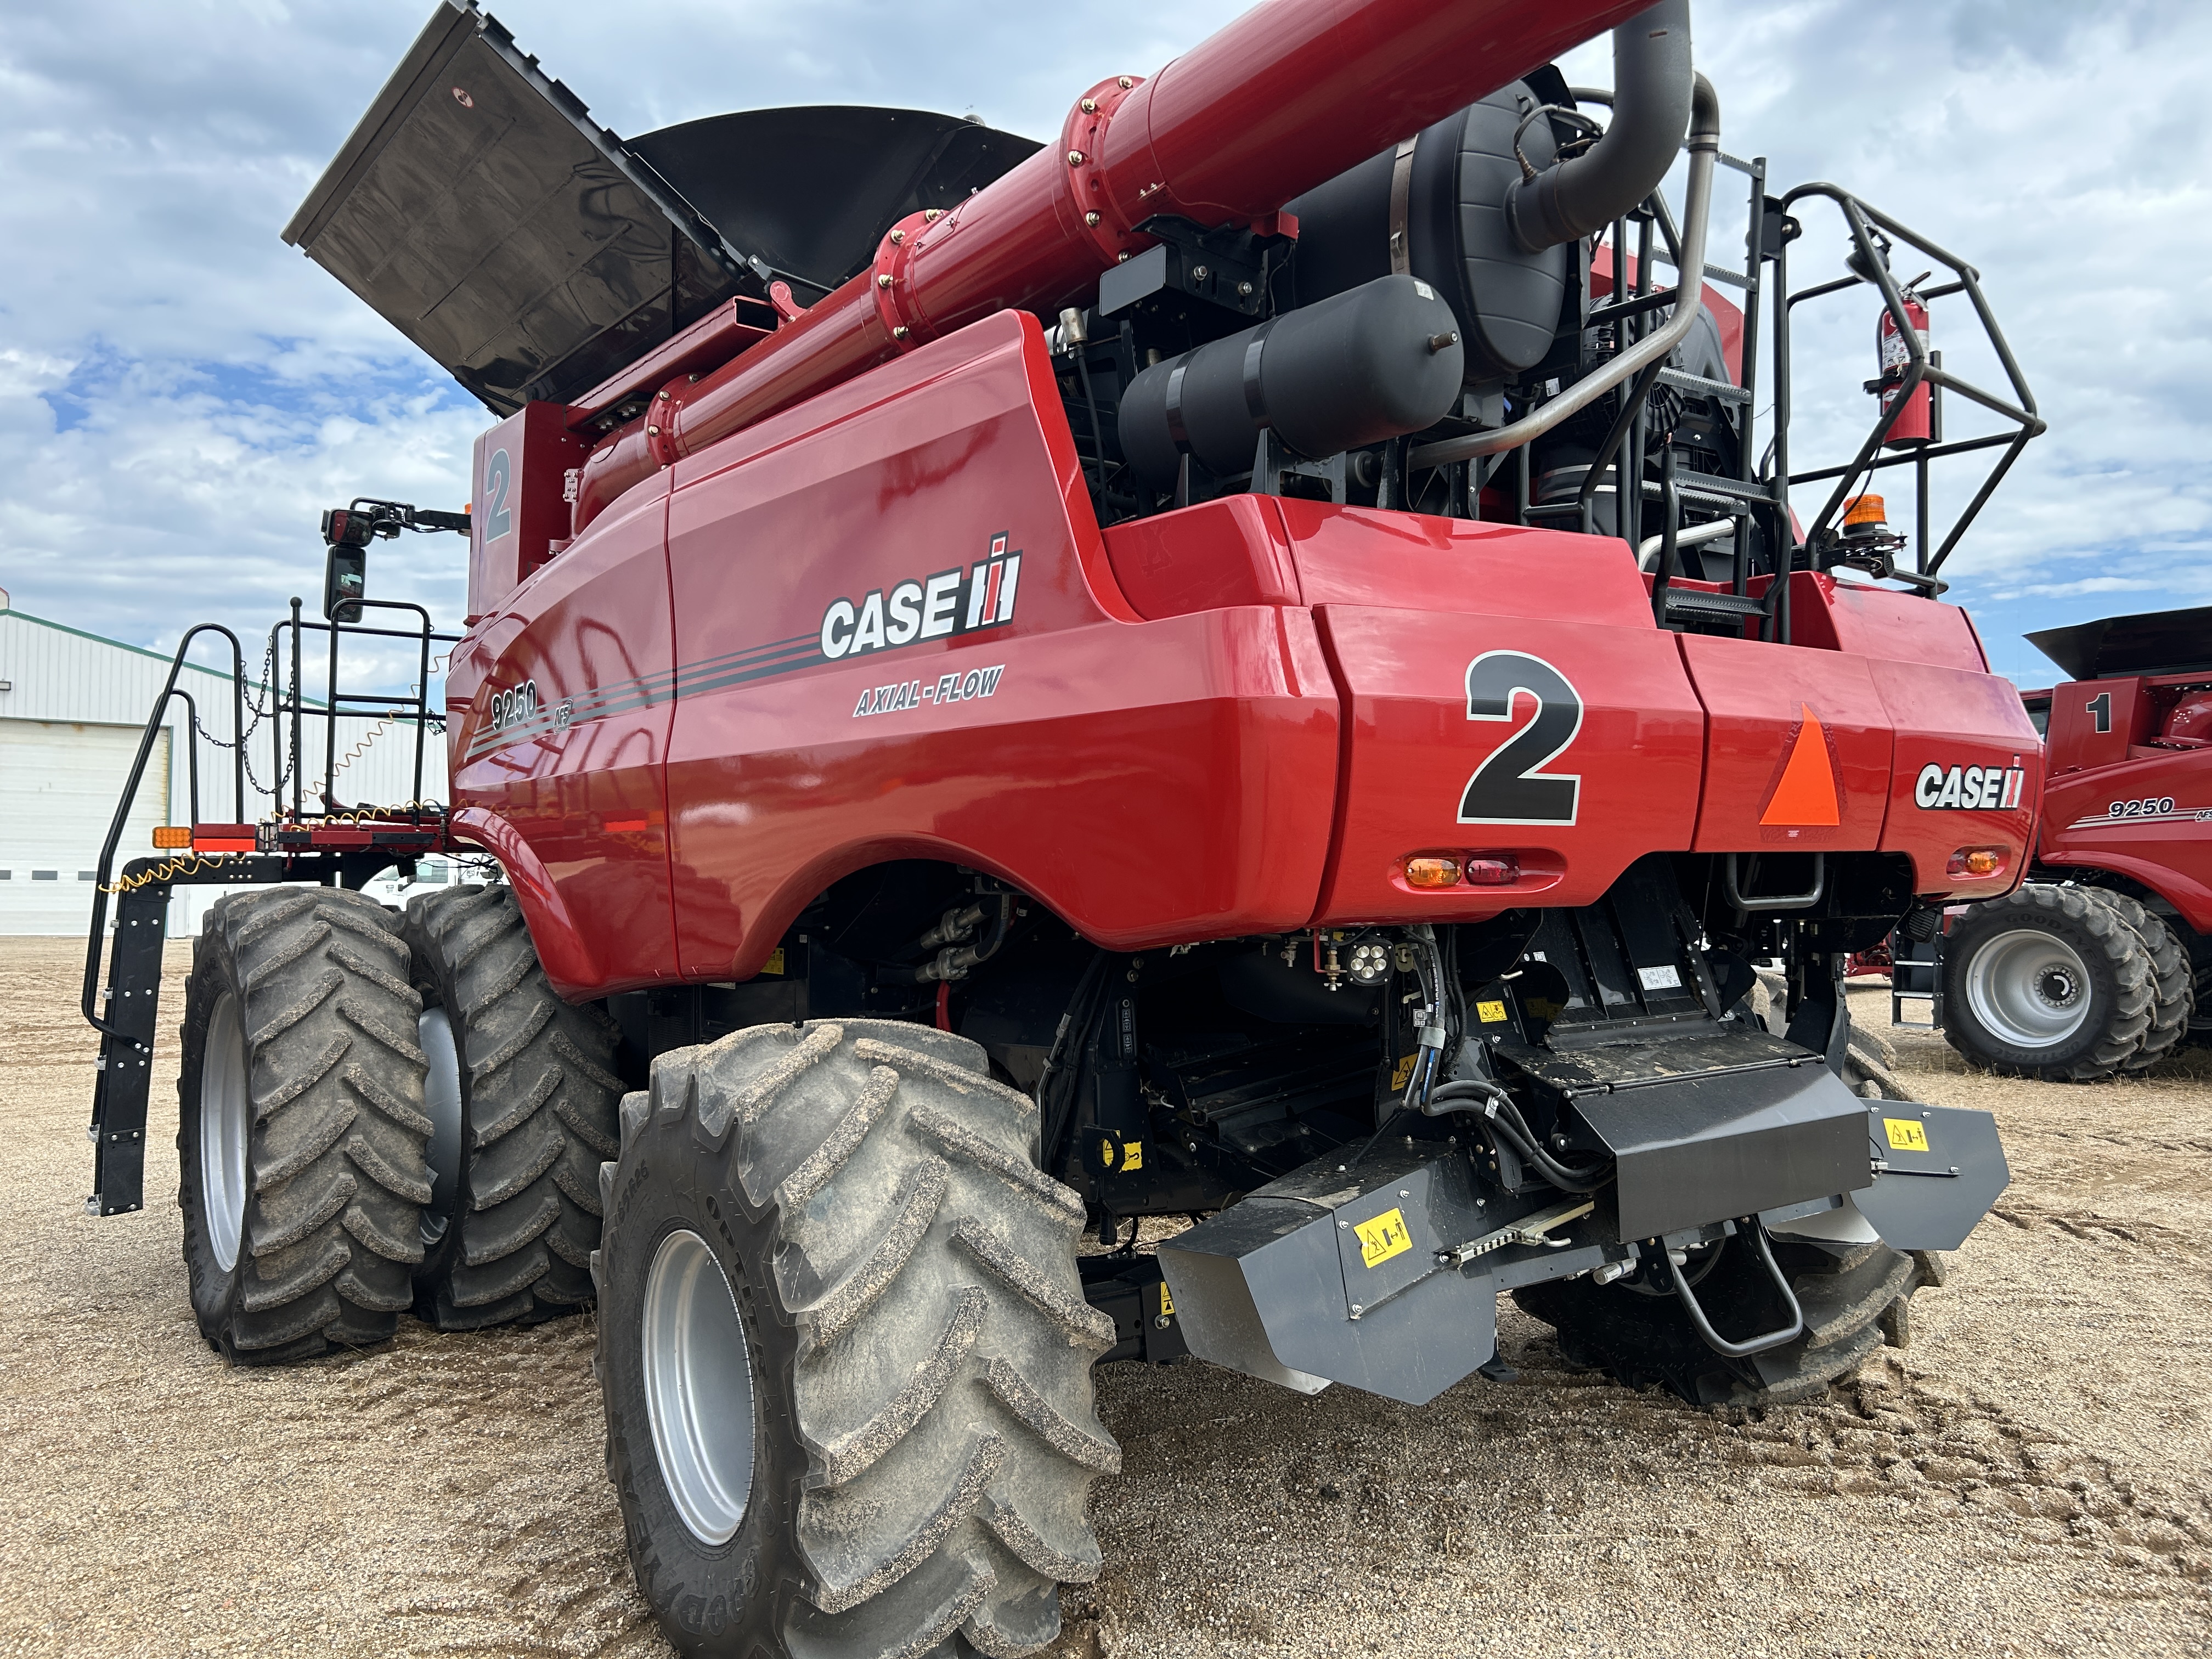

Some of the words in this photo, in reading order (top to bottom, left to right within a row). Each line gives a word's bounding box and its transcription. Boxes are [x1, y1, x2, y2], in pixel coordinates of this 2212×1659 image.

[486, 447, 512, 545] 2
[821, 571, 962, 659] CASE
[492, 678, 538, 733] 9250
[853, 664, 1006, 718] AXIAL-FLOW
[2085, 692, 2112, 734] 1
[1456, 649, 1584, 826] 2
[1915, 764, 2002, 809] CASE
[2108, 796, 2175, 819] 9250
[2005, 912, 2107, 995] GOODYEAR
[1991, 1041, 2081, 1063] OPTITRAC
[182, 1134, 205, 1290] OPTITRAC
[706, 1194, 775, 1470] OPTITRAC
[611, 1409, 762, 1637] GOODYEAR
